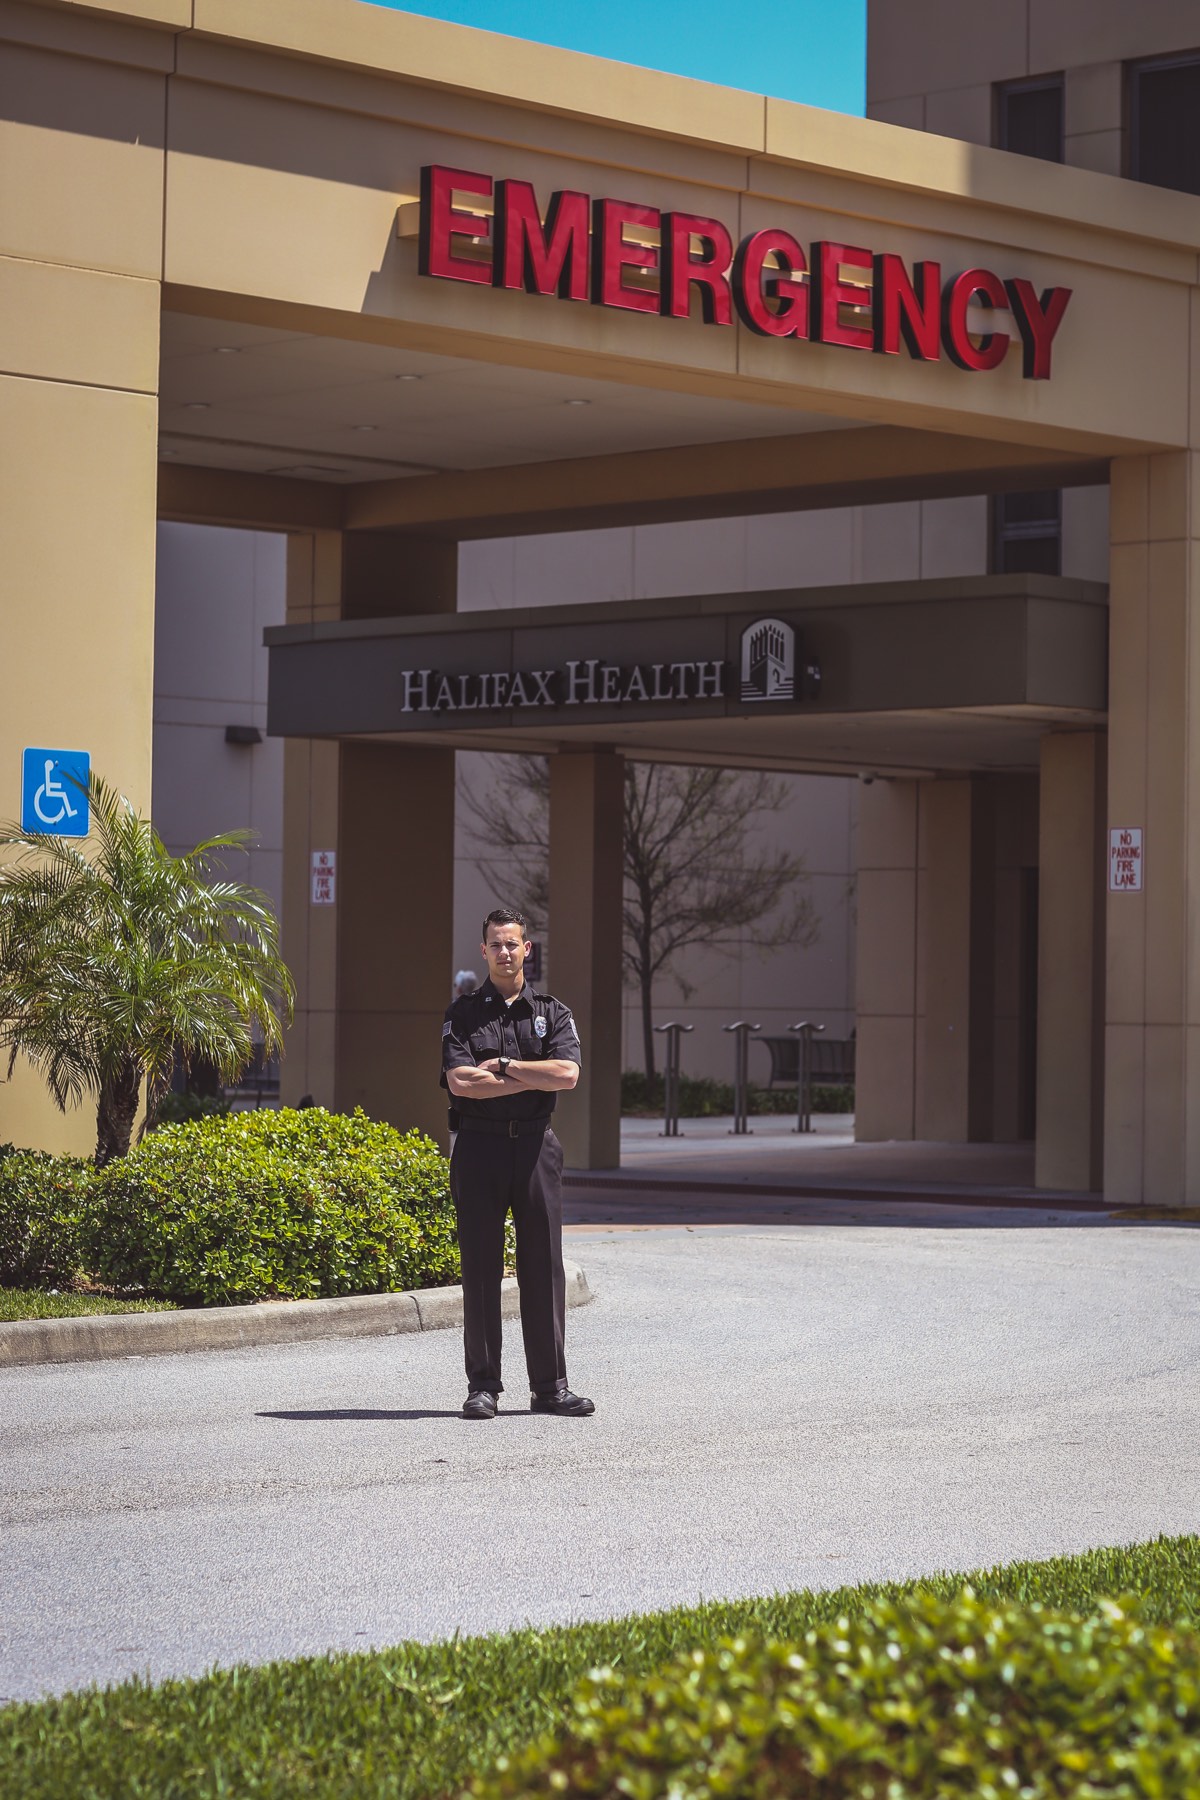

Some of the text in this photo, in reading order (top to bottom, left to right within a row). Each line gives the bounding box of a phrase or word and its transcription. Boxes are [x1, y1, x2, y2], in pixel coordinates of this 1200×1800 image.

[419, 164, 1072, 380] EMERGENCY
[401, 659, 725, 712] HALIFAX HEALTH
[1120, 833, 1132, 846] NO
[1111, 847, 1141, 859] PARKING
[319, 855, 329, 866] NO
[1117, 860, 1135, 873] FIRE
[1115, 873, 1137, 886] LANE
